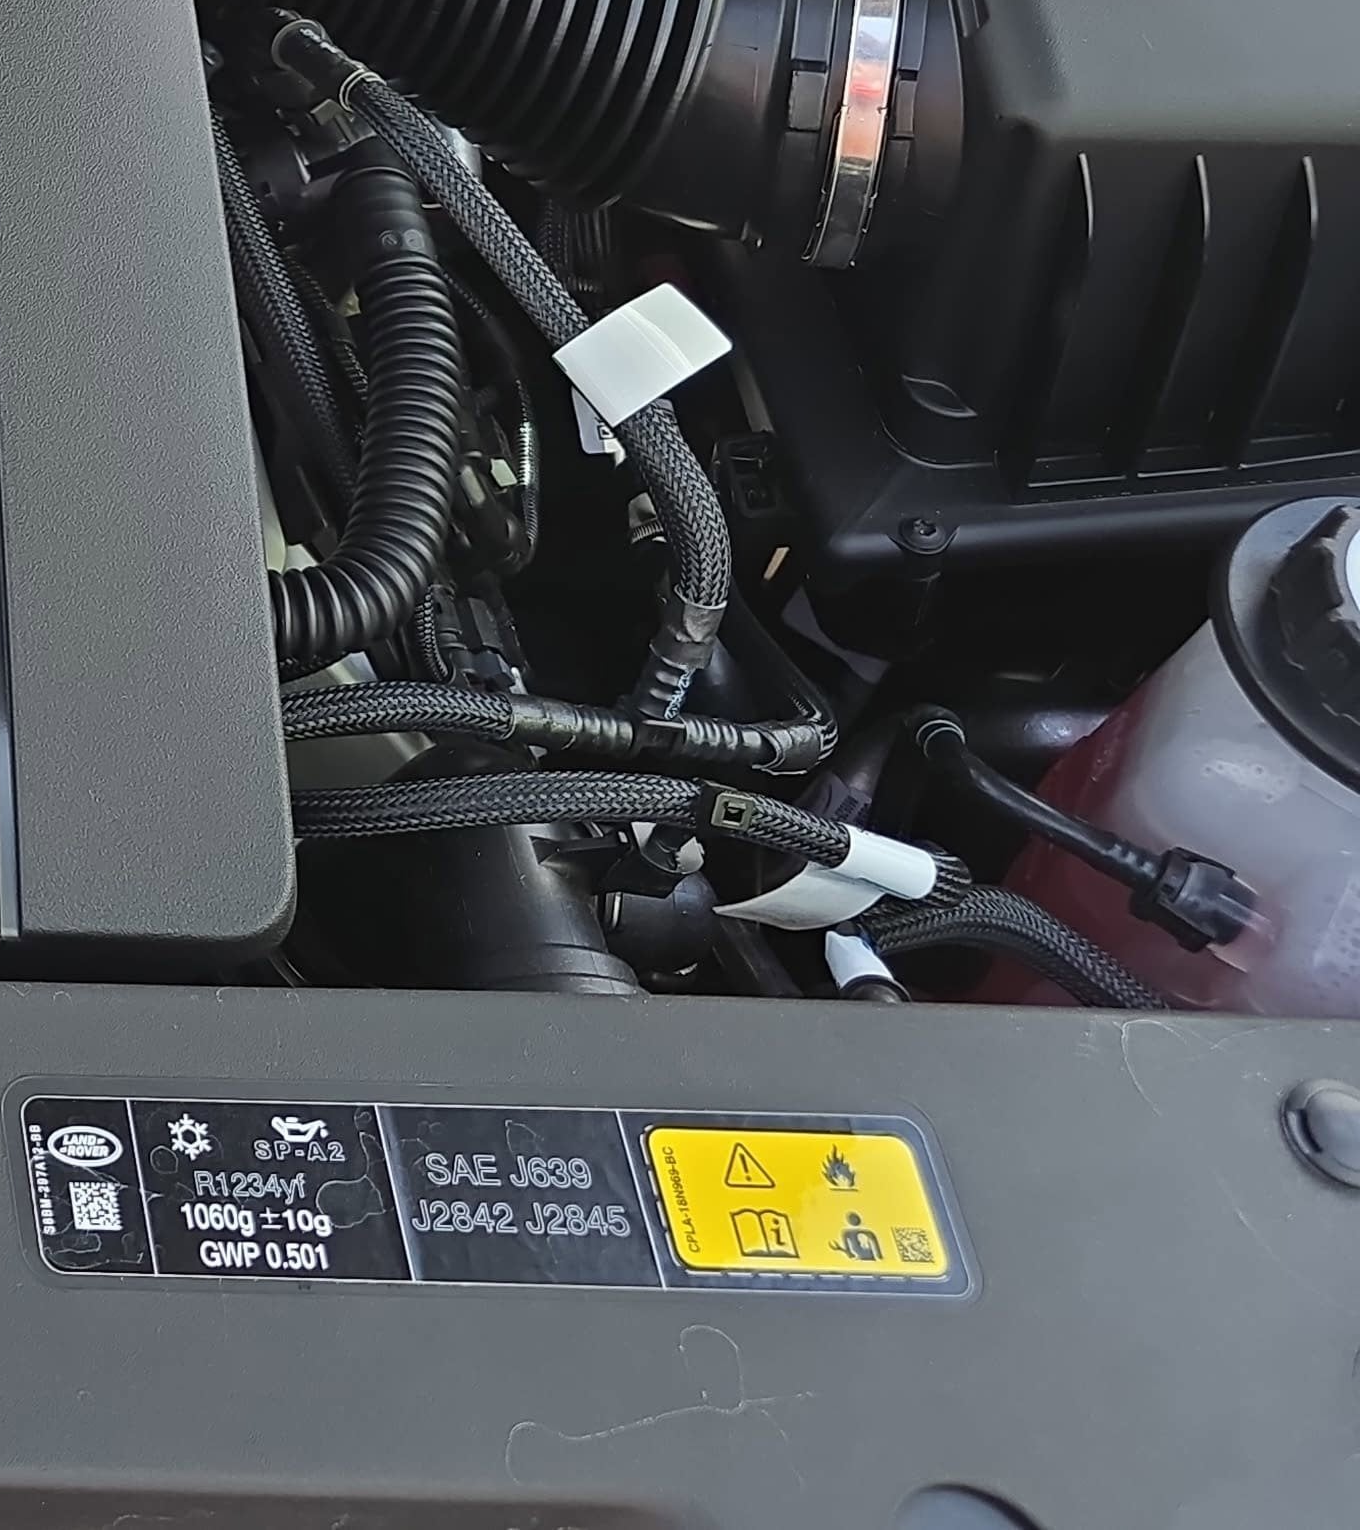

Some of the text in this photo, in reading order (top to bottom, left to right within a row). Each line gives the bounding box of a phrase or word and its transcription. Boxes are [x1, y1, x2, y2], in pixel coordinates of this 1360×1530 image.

[62, 1134, 97, 1146] LAND
[66, 1145, 110, 1158] ROVER
[253, 1139, 346, 1162] SP-A2
[424, 1152, 593, 1190] SAE J639
[193, 1170, 306, 1206] R1234yf
[180, 1202, 332, 1237] 1060g ±10g
[411, 1199, 631, 1237] J2842 J2845
[199, 1240, 330, 1270] GWP 0.501
